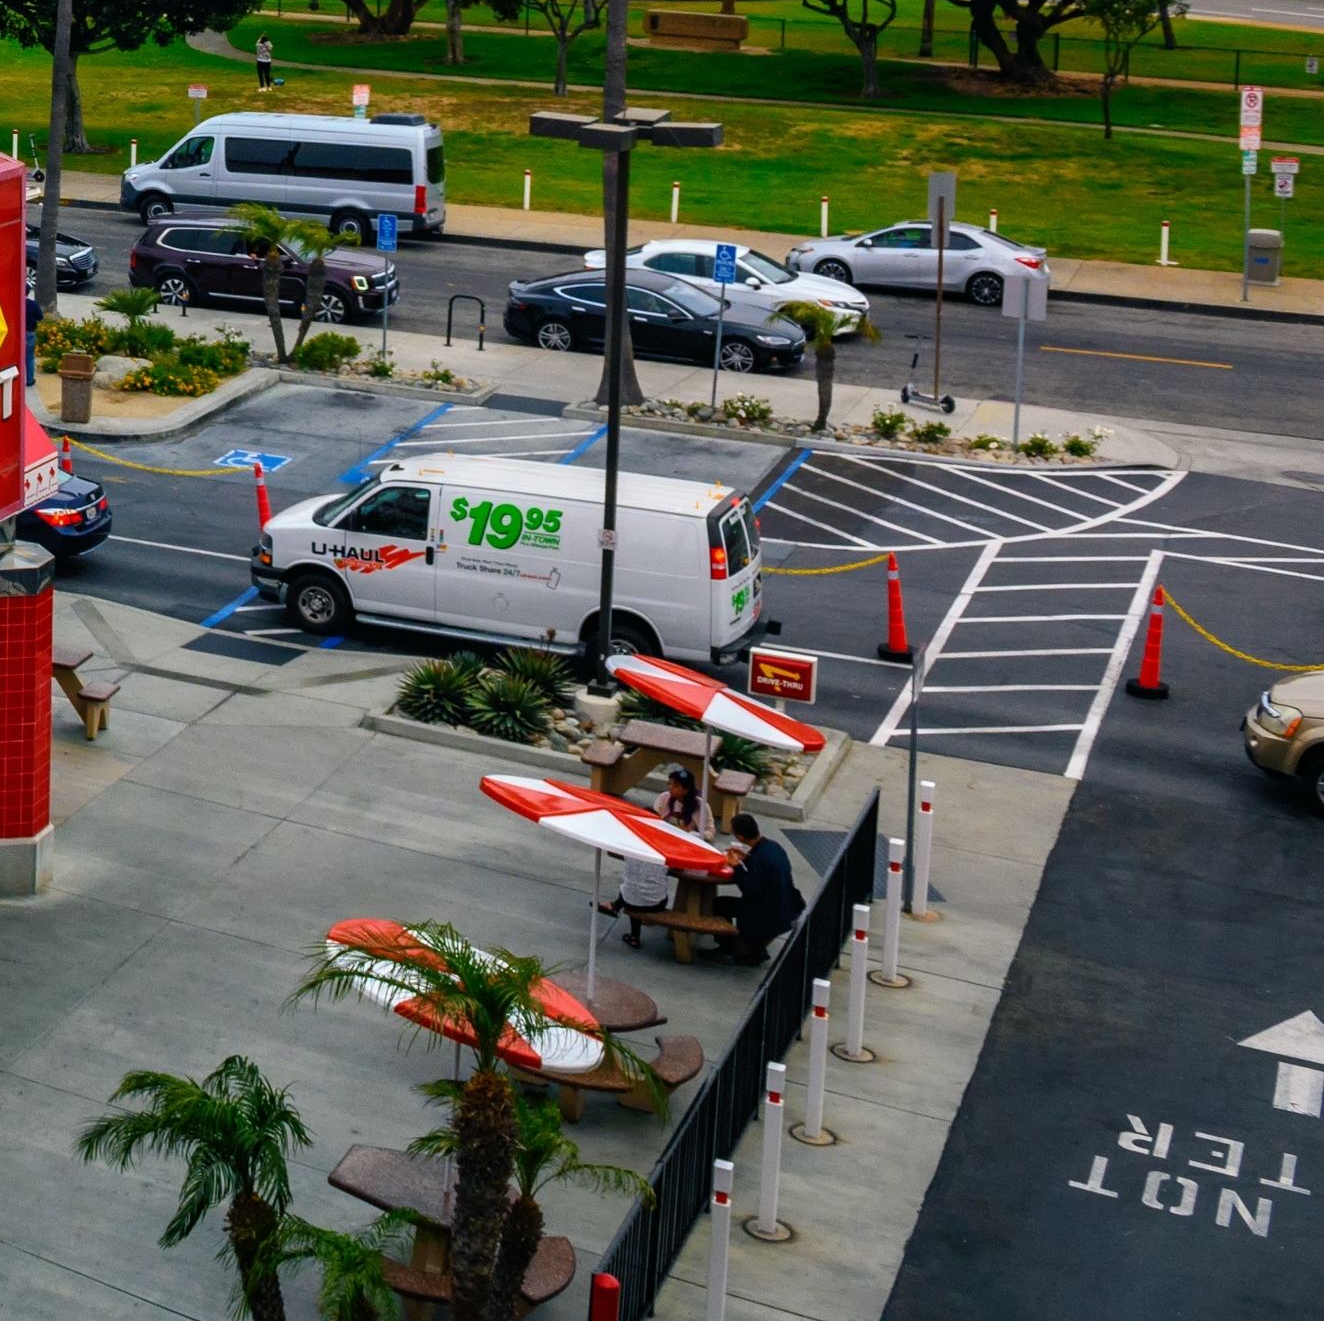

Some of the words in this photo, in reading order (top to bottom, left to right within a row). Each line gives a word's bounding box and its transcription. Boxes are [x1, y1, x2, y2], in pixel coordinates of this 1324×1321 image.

[521, 533, 561, 546] IN-TOWN
[311, 541, 385, 563] U-HAUL
[456, 561, 478, 571] Truck
[479, 564, 502, 575] Share
[503, 568, 520, 578] 24/7
[756, 675, 804, 691] DRIVE-THRU
[1067, 1155, 1273, 1238] NOT
